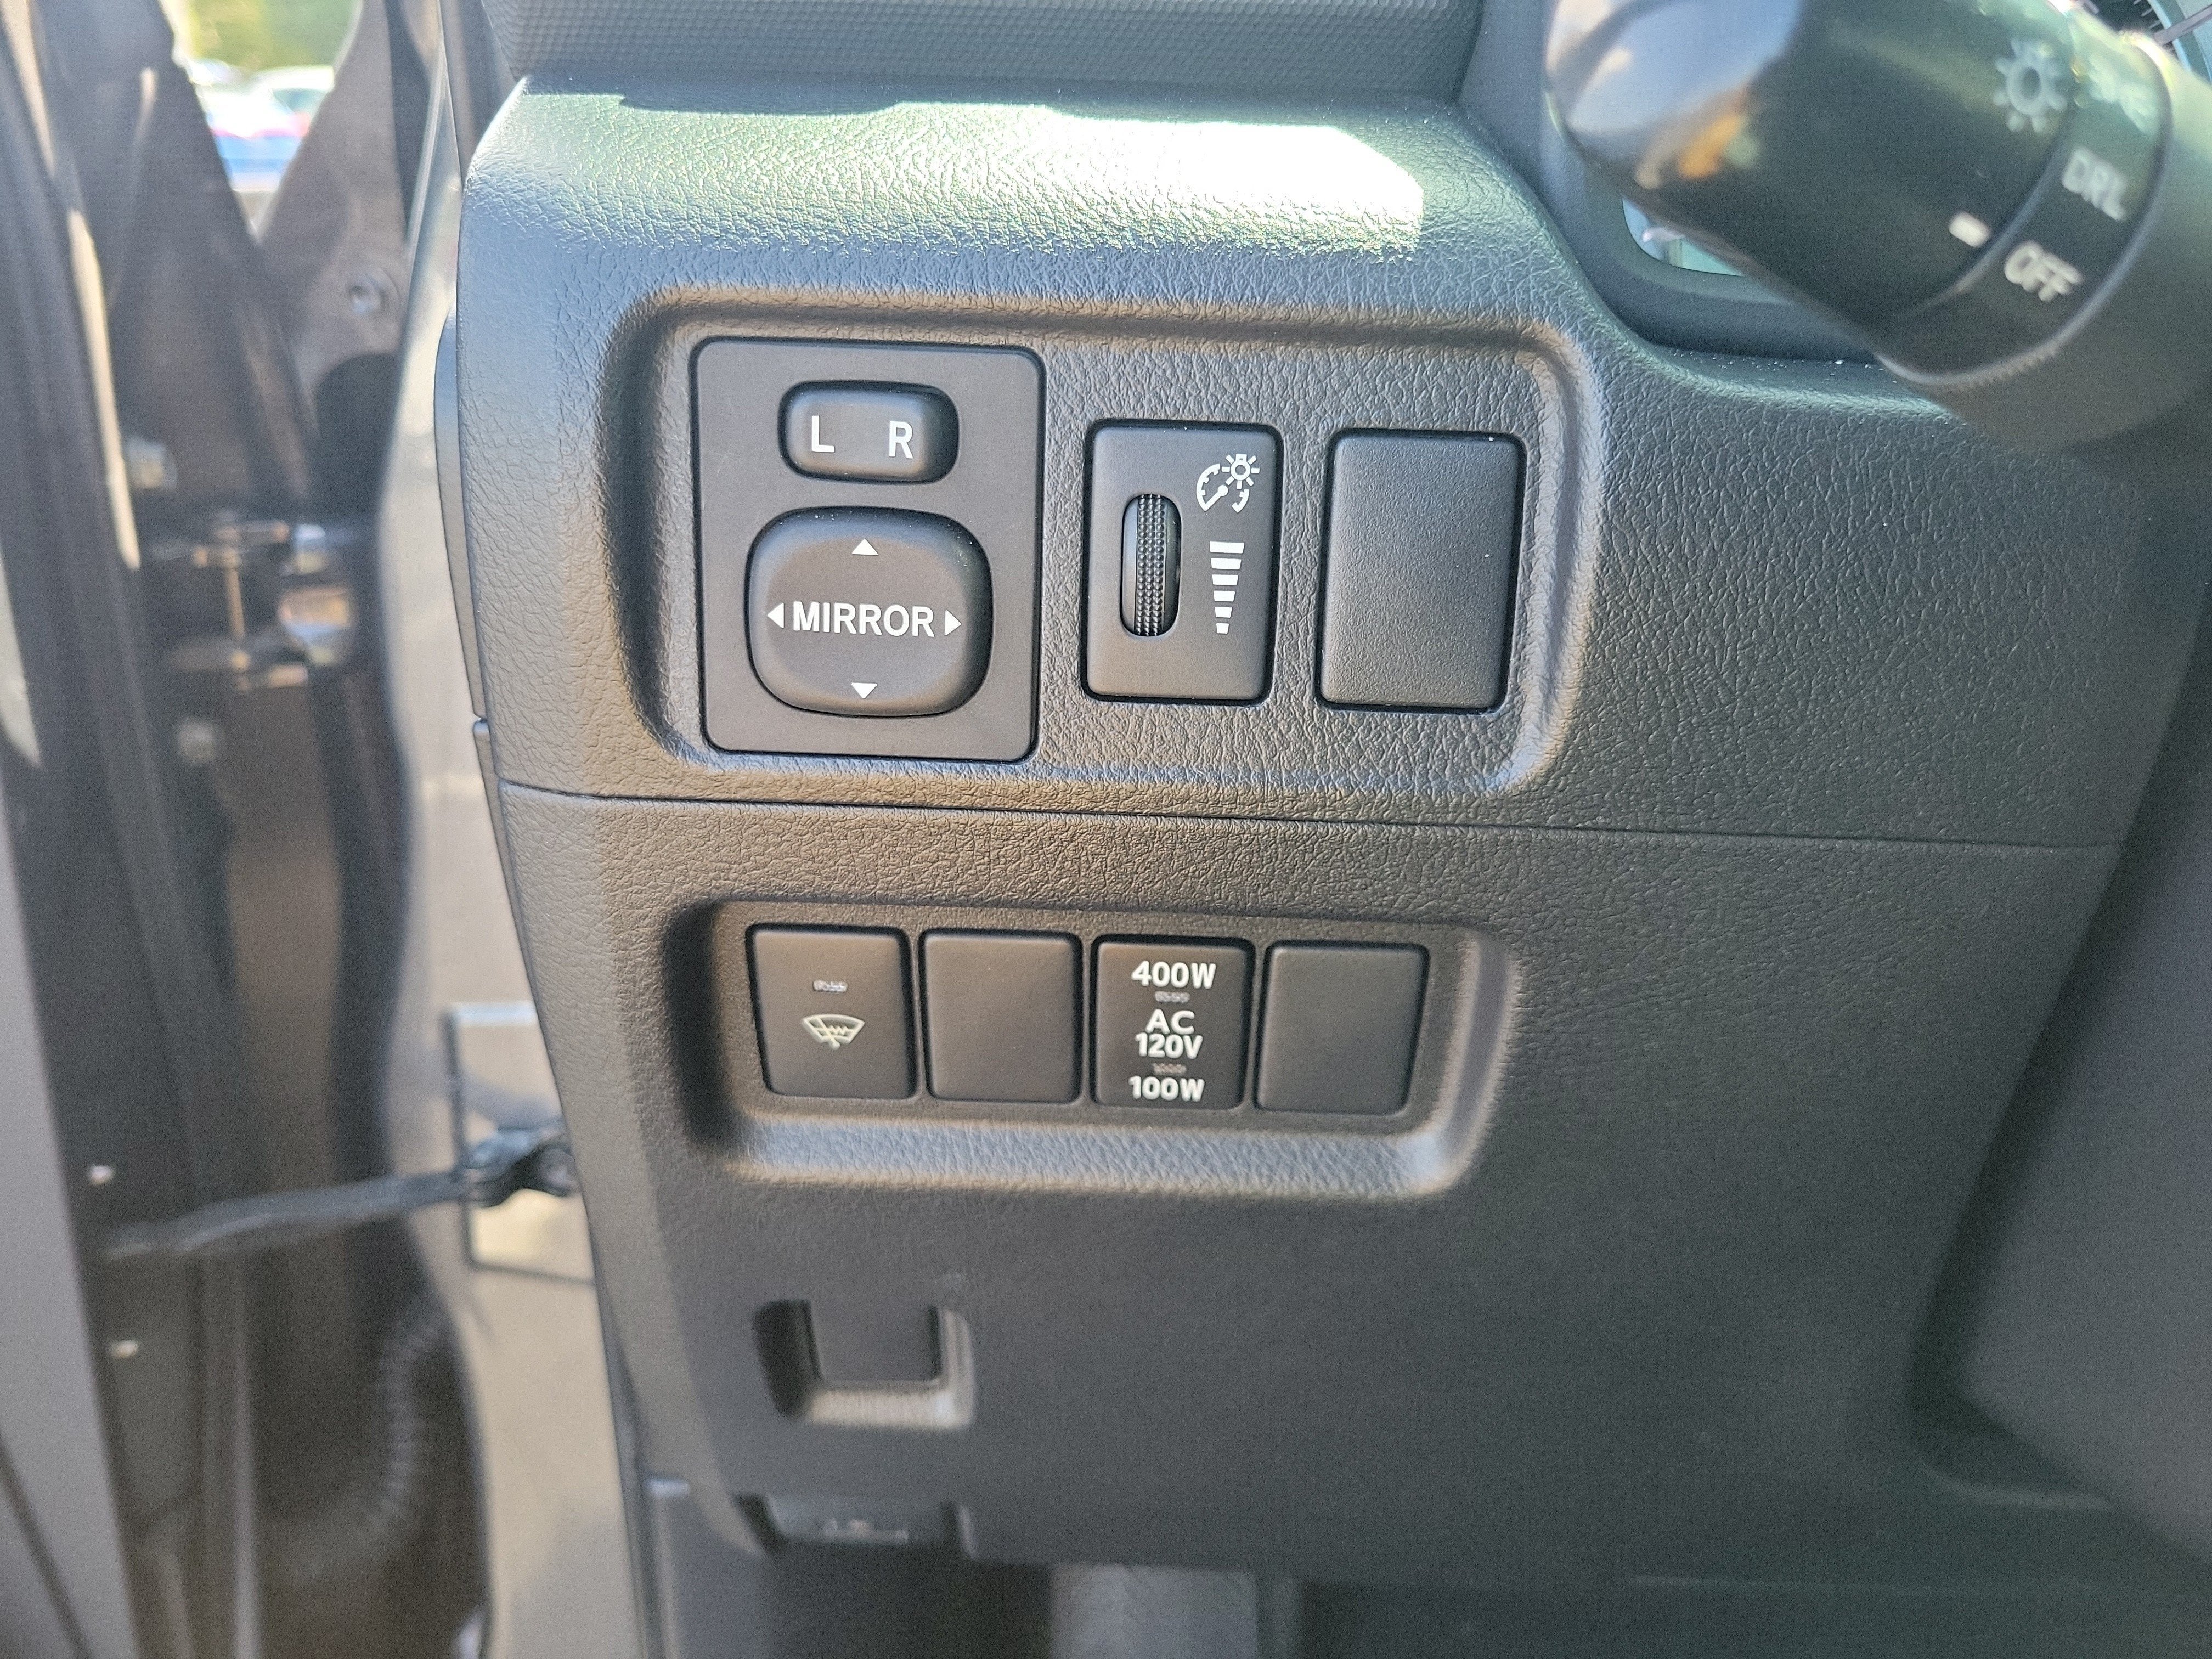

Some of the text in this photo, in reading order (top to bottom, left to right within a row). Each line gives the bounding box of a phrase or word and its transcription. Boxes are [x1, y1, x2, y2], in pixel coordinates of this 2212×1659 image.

[2005, 241, 2082, 301] OFF
[811, 415, 913, 459] L R
[793, 601, 934, 637] MIRROR
[1131, 961, 1216, 989] 400W
[1145, 1009, 1195, 1035] AC
[1135, 1032, 1203, 1059] 120V
[1128, 1075, 1205, 1102] 100W
